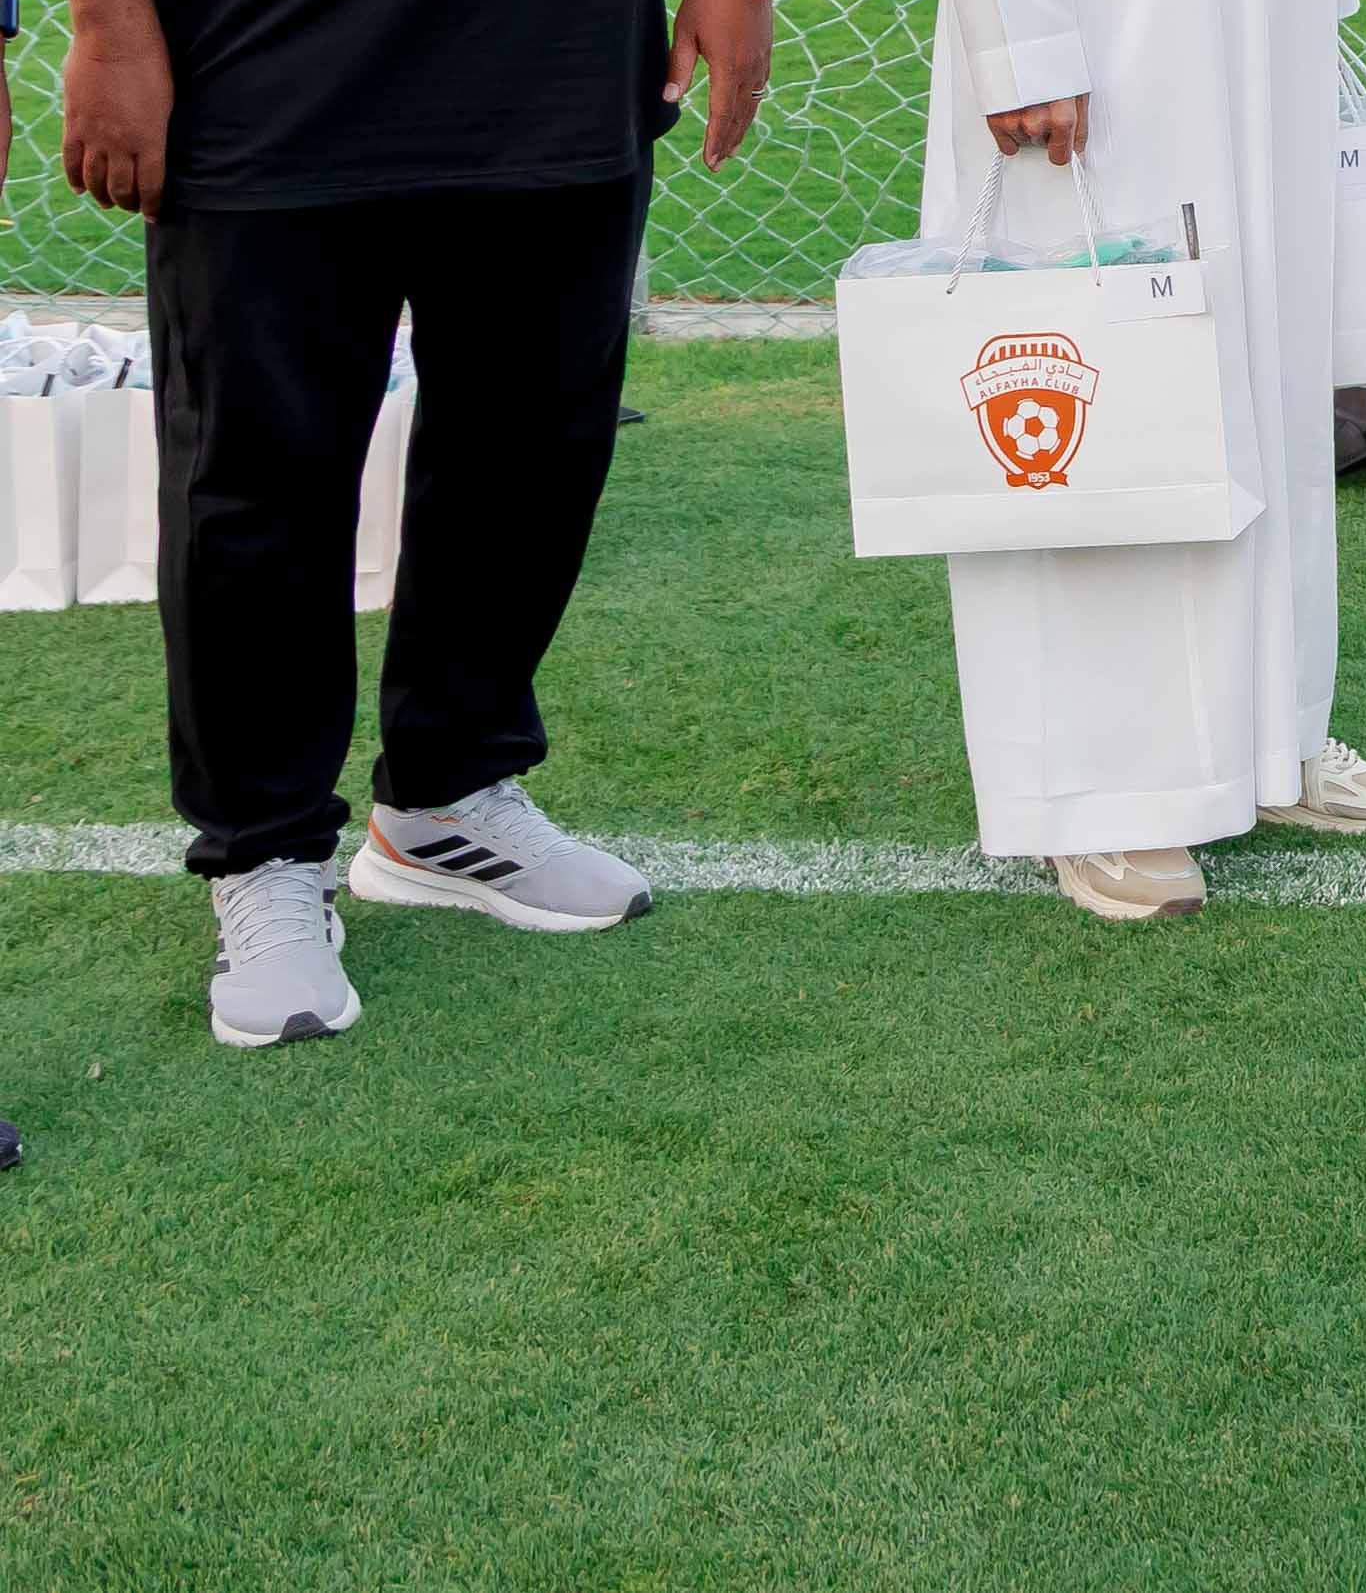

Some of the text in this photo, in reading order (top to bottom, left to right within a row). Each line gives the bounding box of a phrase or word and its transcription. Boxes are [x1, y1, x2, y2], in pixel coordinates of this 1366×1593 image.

[1341, 150, 1359, 168] M
[1150, 275, 1173, 298] M
[979, 377, 1080, 400] ALFAYHA CLUB
[1027, 471, 1051, 483] 1953
